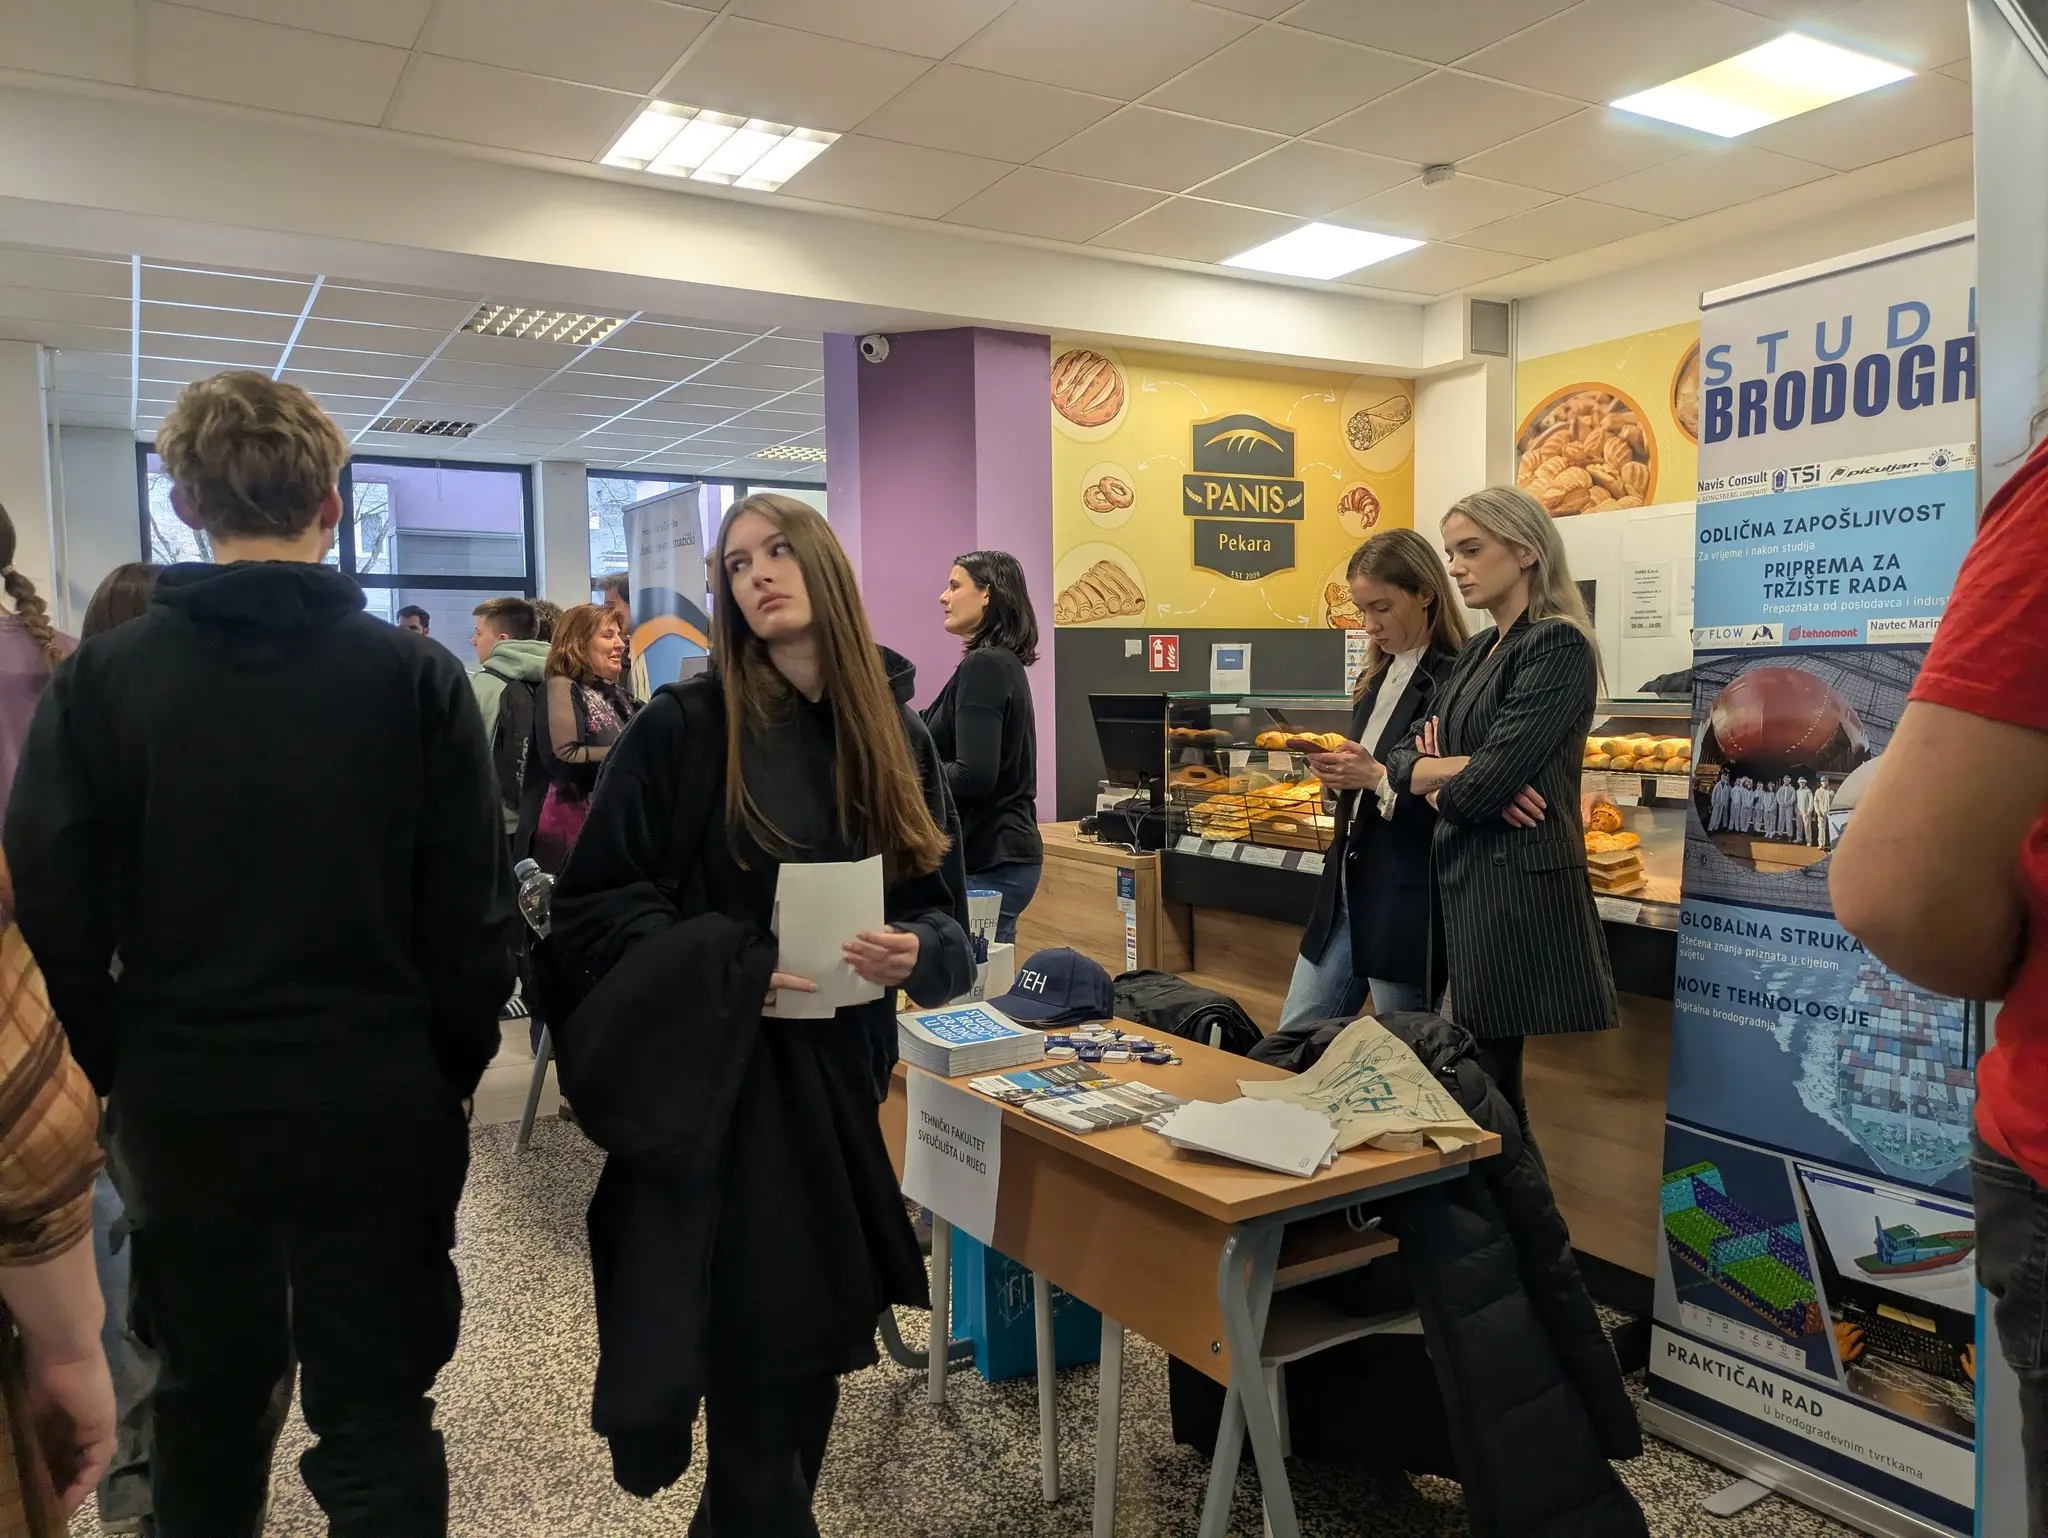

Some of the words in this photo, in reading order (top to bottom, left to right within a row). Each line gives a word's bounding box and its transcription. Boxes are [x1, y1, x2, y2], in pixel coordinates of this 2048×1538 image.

[1704, 336, 1975, 444] BRODOGR
[1697, 478, 1724, 492] Navis
[1728, 471, 1768, 487] Consult
[1702, 492, 1739, 503] KONGSBERG
[1739, 488, 1768, 498] company
[1204, 482, 1285, 514] PANIS
[1699, 519, 1776, 544] ODLIČNA
[1783, 503, 1946, 535] ZAPOŠLJIVOST
[1219, 533, 1271, 552] Pekara
[1698, 551, 1709, 561] Za
[1711, 549, 1743, 561] vrijeme
[1751, 545, 1779, 556] nakon
[1782, 541, 1815, 553] studija
[1764, 557, 1864, 579] PRIPREMA
[1873, 553, 1900, 572] ZA
[1763, 575, 1840, 600] TRŽIŠTE
[1849, 575, 1908, 595] RADA
[1762, 602, 1819, 615] Prepoznata
[1823, 600, 1837, 611] od
[1840, 598, 1902, 613] poslodavca
[1709, 627, 1744, 640] FLOW
[1802, 627, 1858, 639] tehnomont
[1870, 620, 1906, 631] Navtec
[1680, 910, 1773, 941] GLOBALNA
[1780, 927, 1865, 954] STRUKA
[1679, 948, 1705, 961] svijetu
[1680, 934, 1712, 949] Stečena
[1714, 942, 1742, 957] znanja
[1745, 947, 1788, 963] priznata
[1790, 954, 1798, 964] u
[1801, 954, 1840, 971] cijelom
[1675, 999, 1711, 1016] Digitalna
[1712, 1007, 1776, 1032] brodogradnja
[1676, 975, 1720, 999] NOVE
[1727, 985, 1870, 1028] TEHNOLOGIJE
[920, 1110, 950, 1134] TEHNIČKI
[951, 1126, 985, 1152] FAKULTET
[918, 1129, 958, 1160] SVEUČILIŠTA
[959, 1150, 965, 1163] U
[966, 1154, 987, 1175] RIJECI
[1667, 1342, 1774, 1400] PRAKTIČAN
[1782, 1388, 1823, 1418] RAD
[1763, 1403, 1771, 1415] U
[1774, 1406, 1864, 1455] brodograđevnim
[1868, 1448, 1924, 1480] tvrtkama
